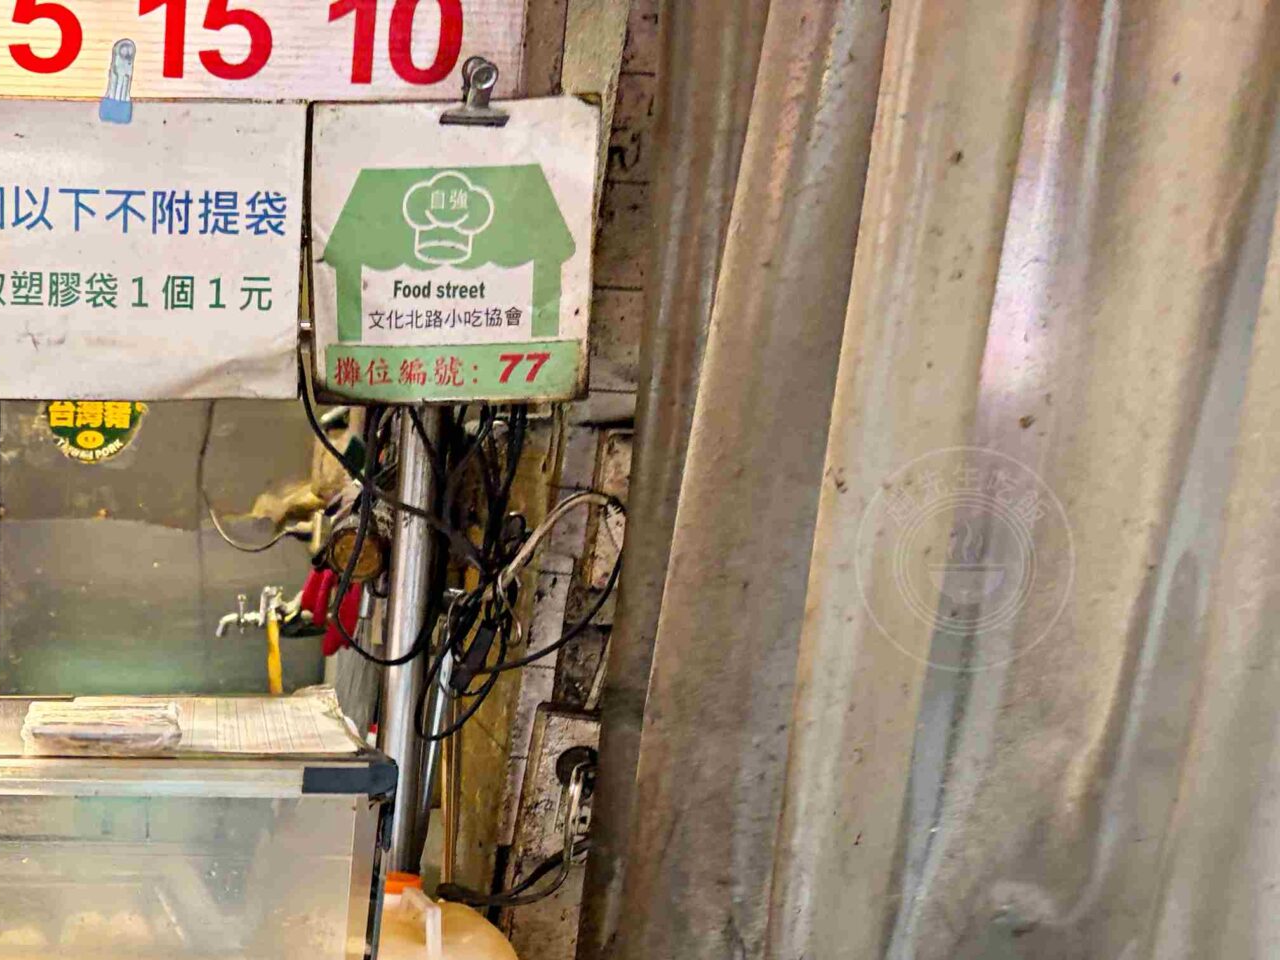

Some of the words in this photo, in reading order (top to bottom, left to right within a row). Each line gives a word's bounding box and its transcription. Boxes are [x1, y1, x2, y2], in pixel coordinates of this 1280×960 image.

[138, 0, 273, 80] 15
[327, 0, 464, 85] 10
[393, 279, 432, 299] Food
[436, 280, 486, 299] street
[368, 306, 523, 331] 文化北路小吃協會
